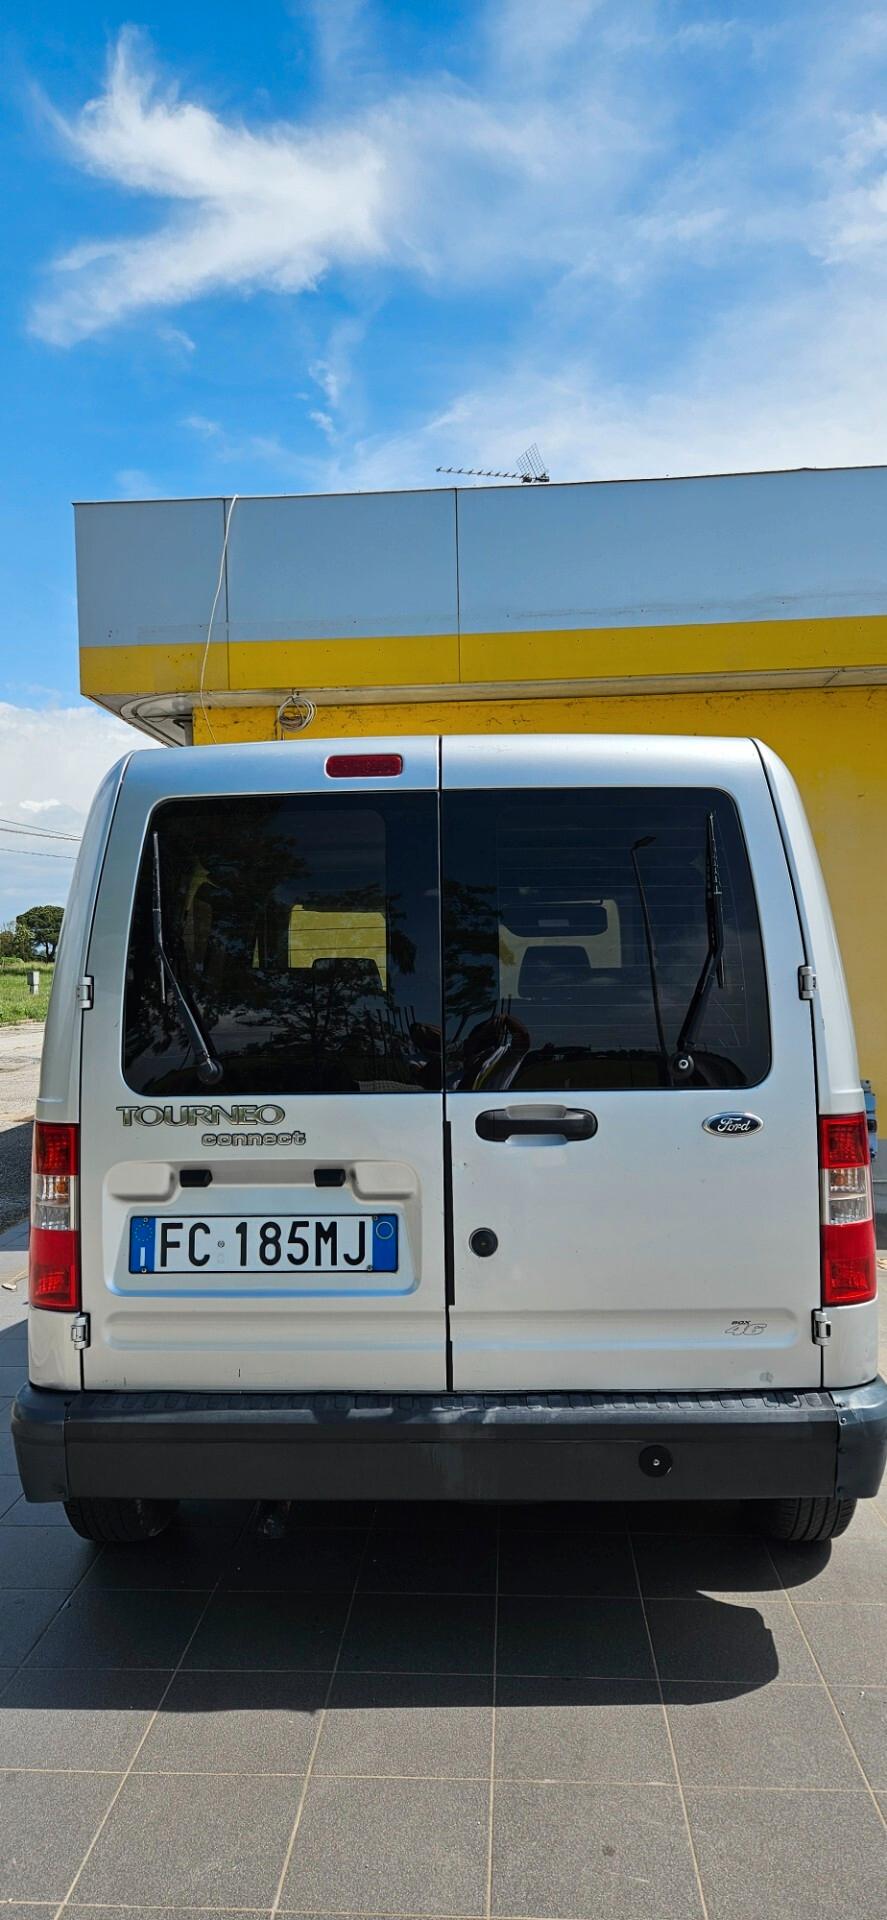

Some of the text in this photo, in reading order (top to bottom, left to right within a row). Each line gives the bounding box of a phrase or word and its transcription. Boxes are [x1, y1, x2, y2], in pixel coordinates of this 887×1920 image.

[116, 1104, 285, 1127] TOURNEO
[717, 1117, 751, 1131] Ford
[201, 1131, 306, 1147] connect
[140, 1220, 366, 1267] I FC 185MJ
